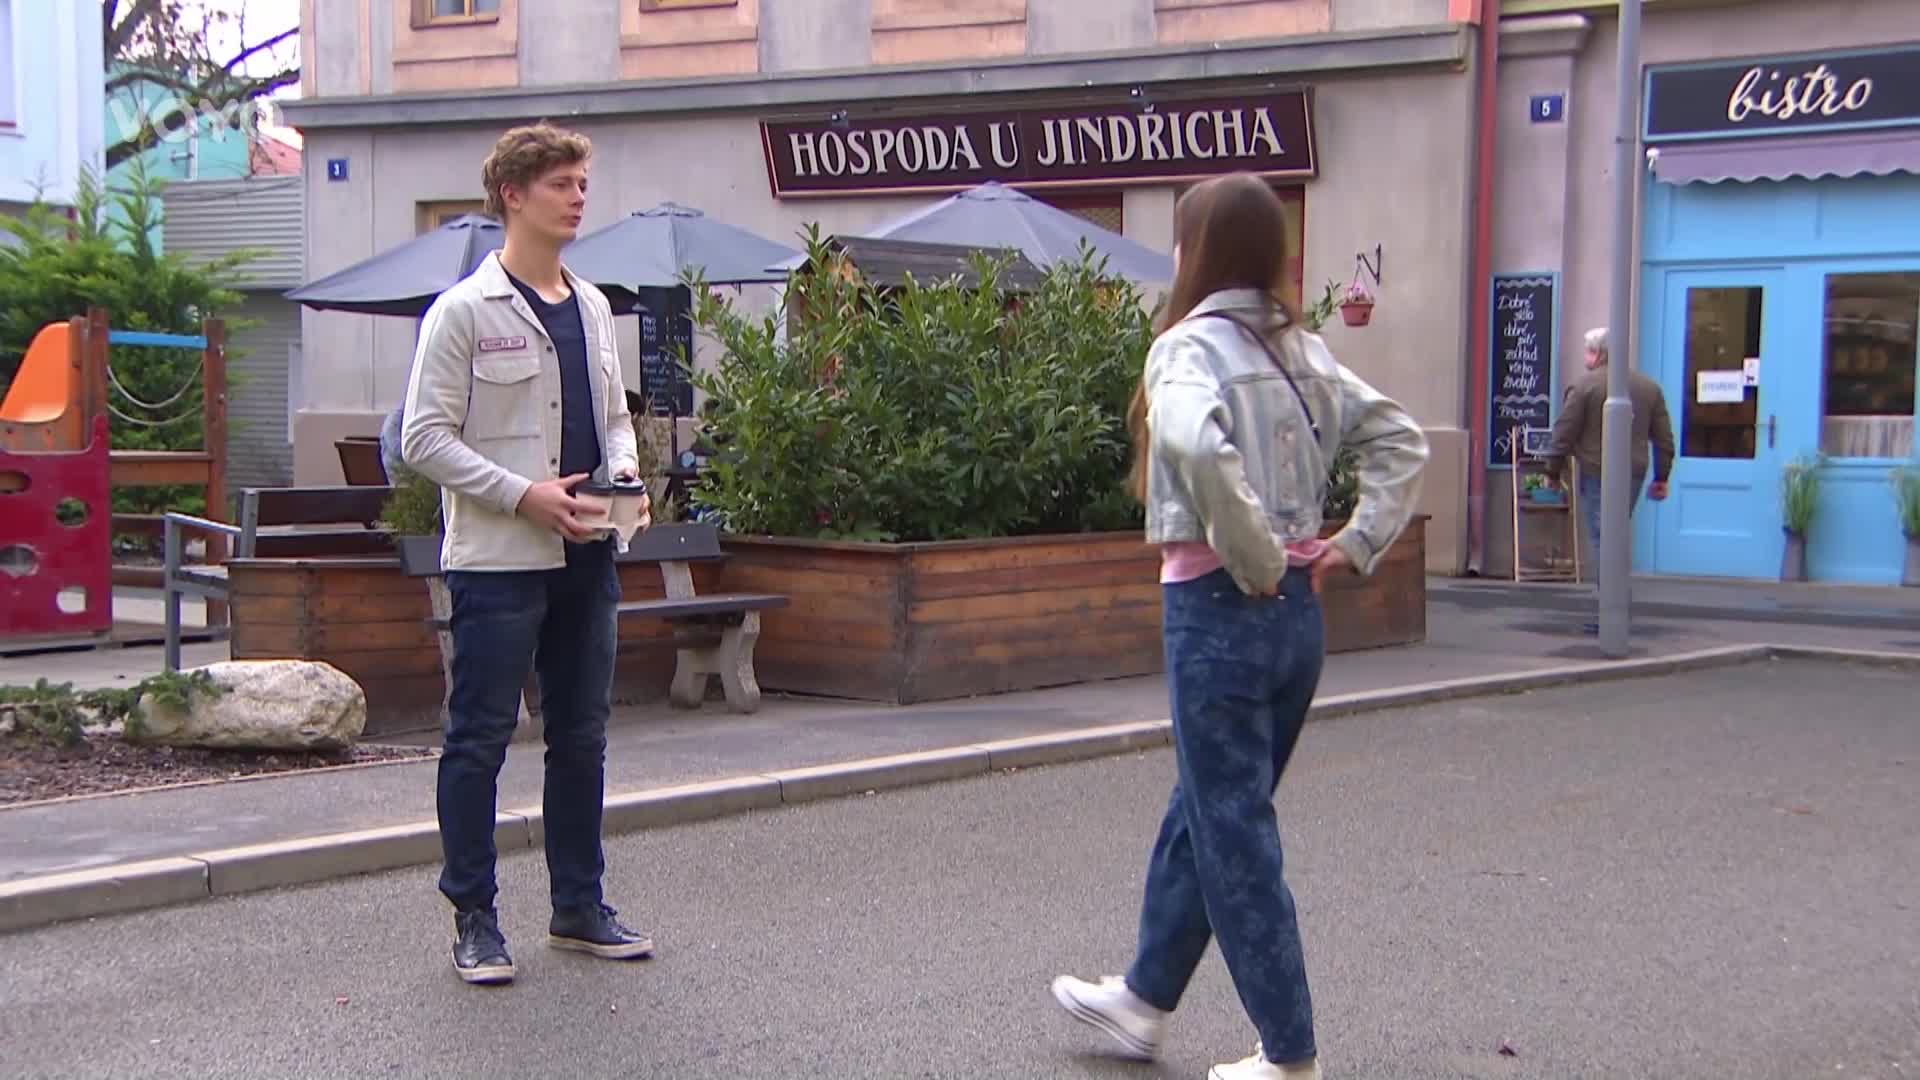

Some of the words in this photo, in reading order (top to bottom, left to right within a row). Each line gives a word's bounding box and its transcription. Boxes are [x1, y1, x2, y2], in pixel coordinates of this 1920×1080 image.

[1727, 64, 1873, 122] bistro
[1542, 100, 1550, 117] 5
[788, 125, 983, 177] HOSPODA
[988, 121, 1019, 169] U
[1037, 104, 1285, 166] JINDŘICHA
[1497, 293, 1535, 310] Dobré
[1503, 320, 1528, 337] dobré
